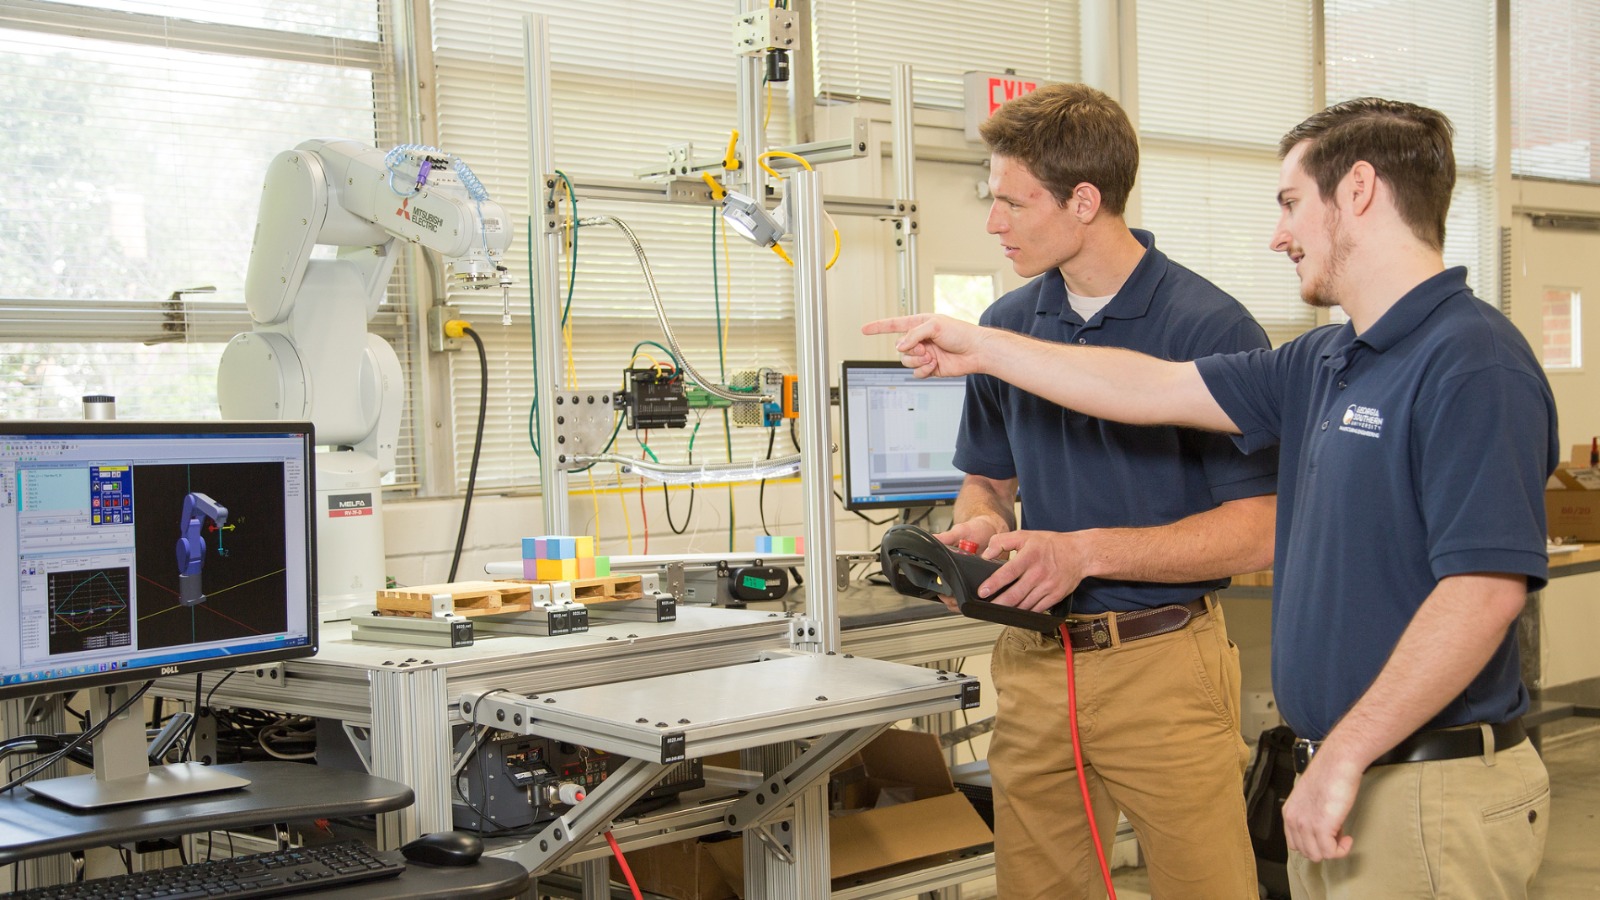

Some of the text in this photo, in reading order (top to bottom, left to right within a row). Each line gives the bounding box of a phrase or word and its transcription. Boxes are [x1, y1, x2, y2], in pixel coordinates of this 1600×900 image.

[988, 77, 1036, 117] EX
[412, 206, 443, 227] MITSUBISHI
[411, 214, 438, 233] ELECTRIC
[1356, 405, 1379, 417] GEORGIA
[1353, 413, 1384, 425] SOUTHERN
[339, 500, 365, 508] MELFA
[161, 666, 179, 675] DELL
